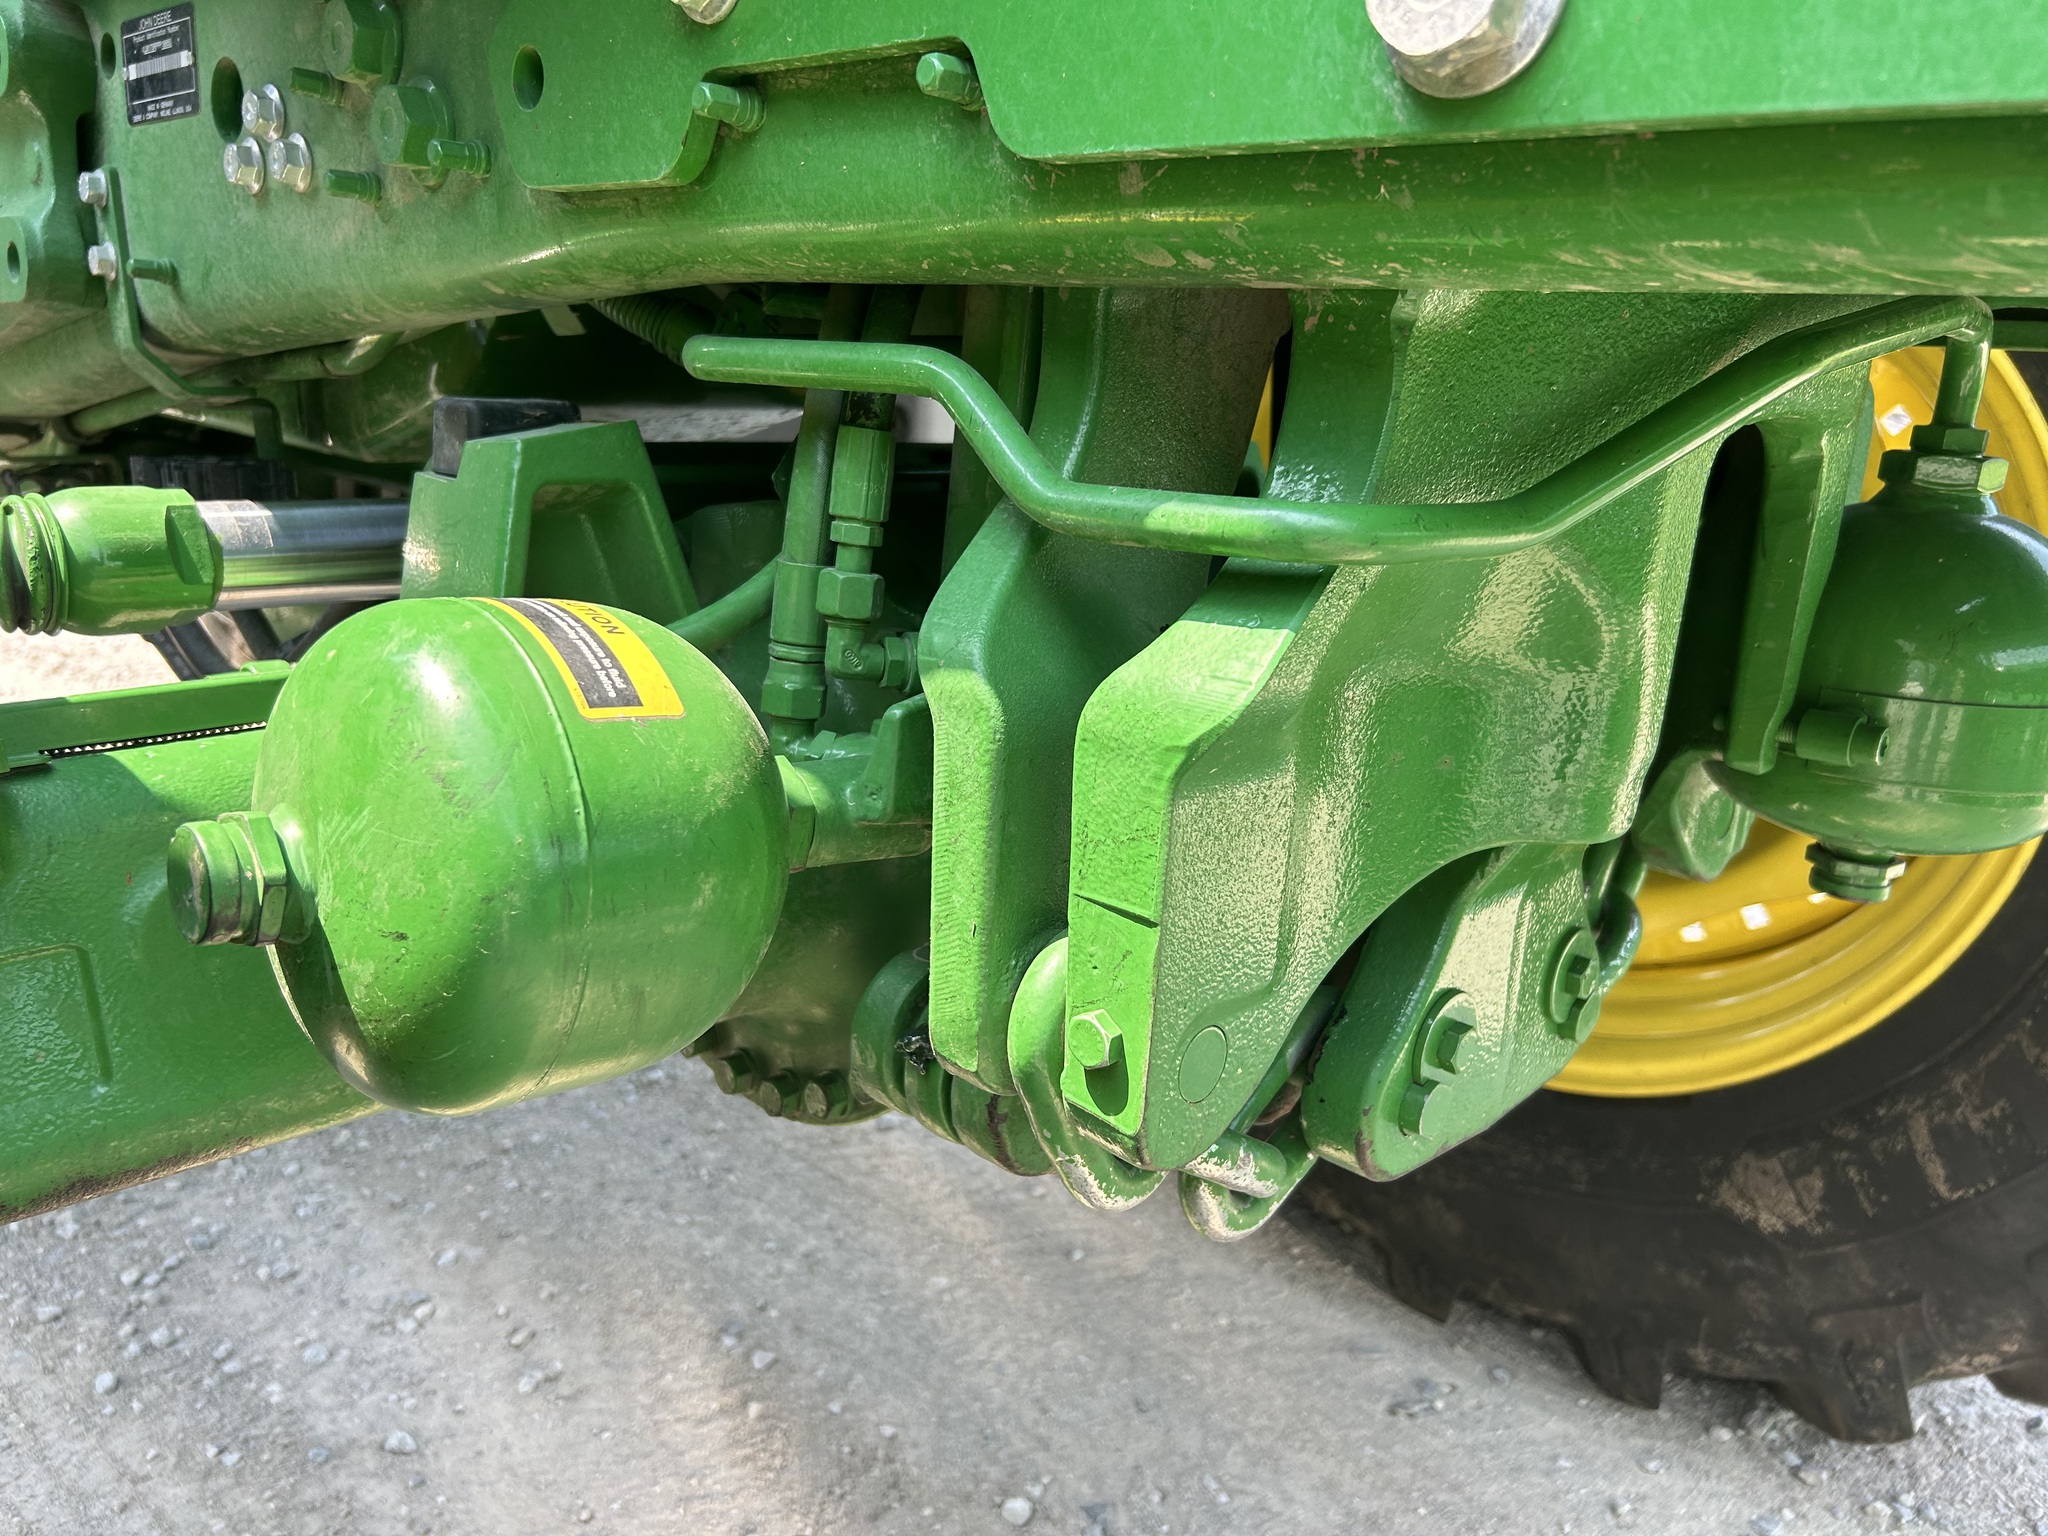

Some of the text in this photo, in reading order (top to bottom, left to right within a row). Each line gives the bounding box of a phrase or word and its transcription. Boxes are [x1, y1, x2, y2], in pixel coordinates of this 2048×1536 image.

[139, 10, 172, 31] JOHN DEERE
[572, 639, 602, 670] pressure
[595, 670, 617, 698] before
[574, 626, 606, 658] exposure
[601, 658, 613, 668] to
[607, 668, 627, 689] fluid
